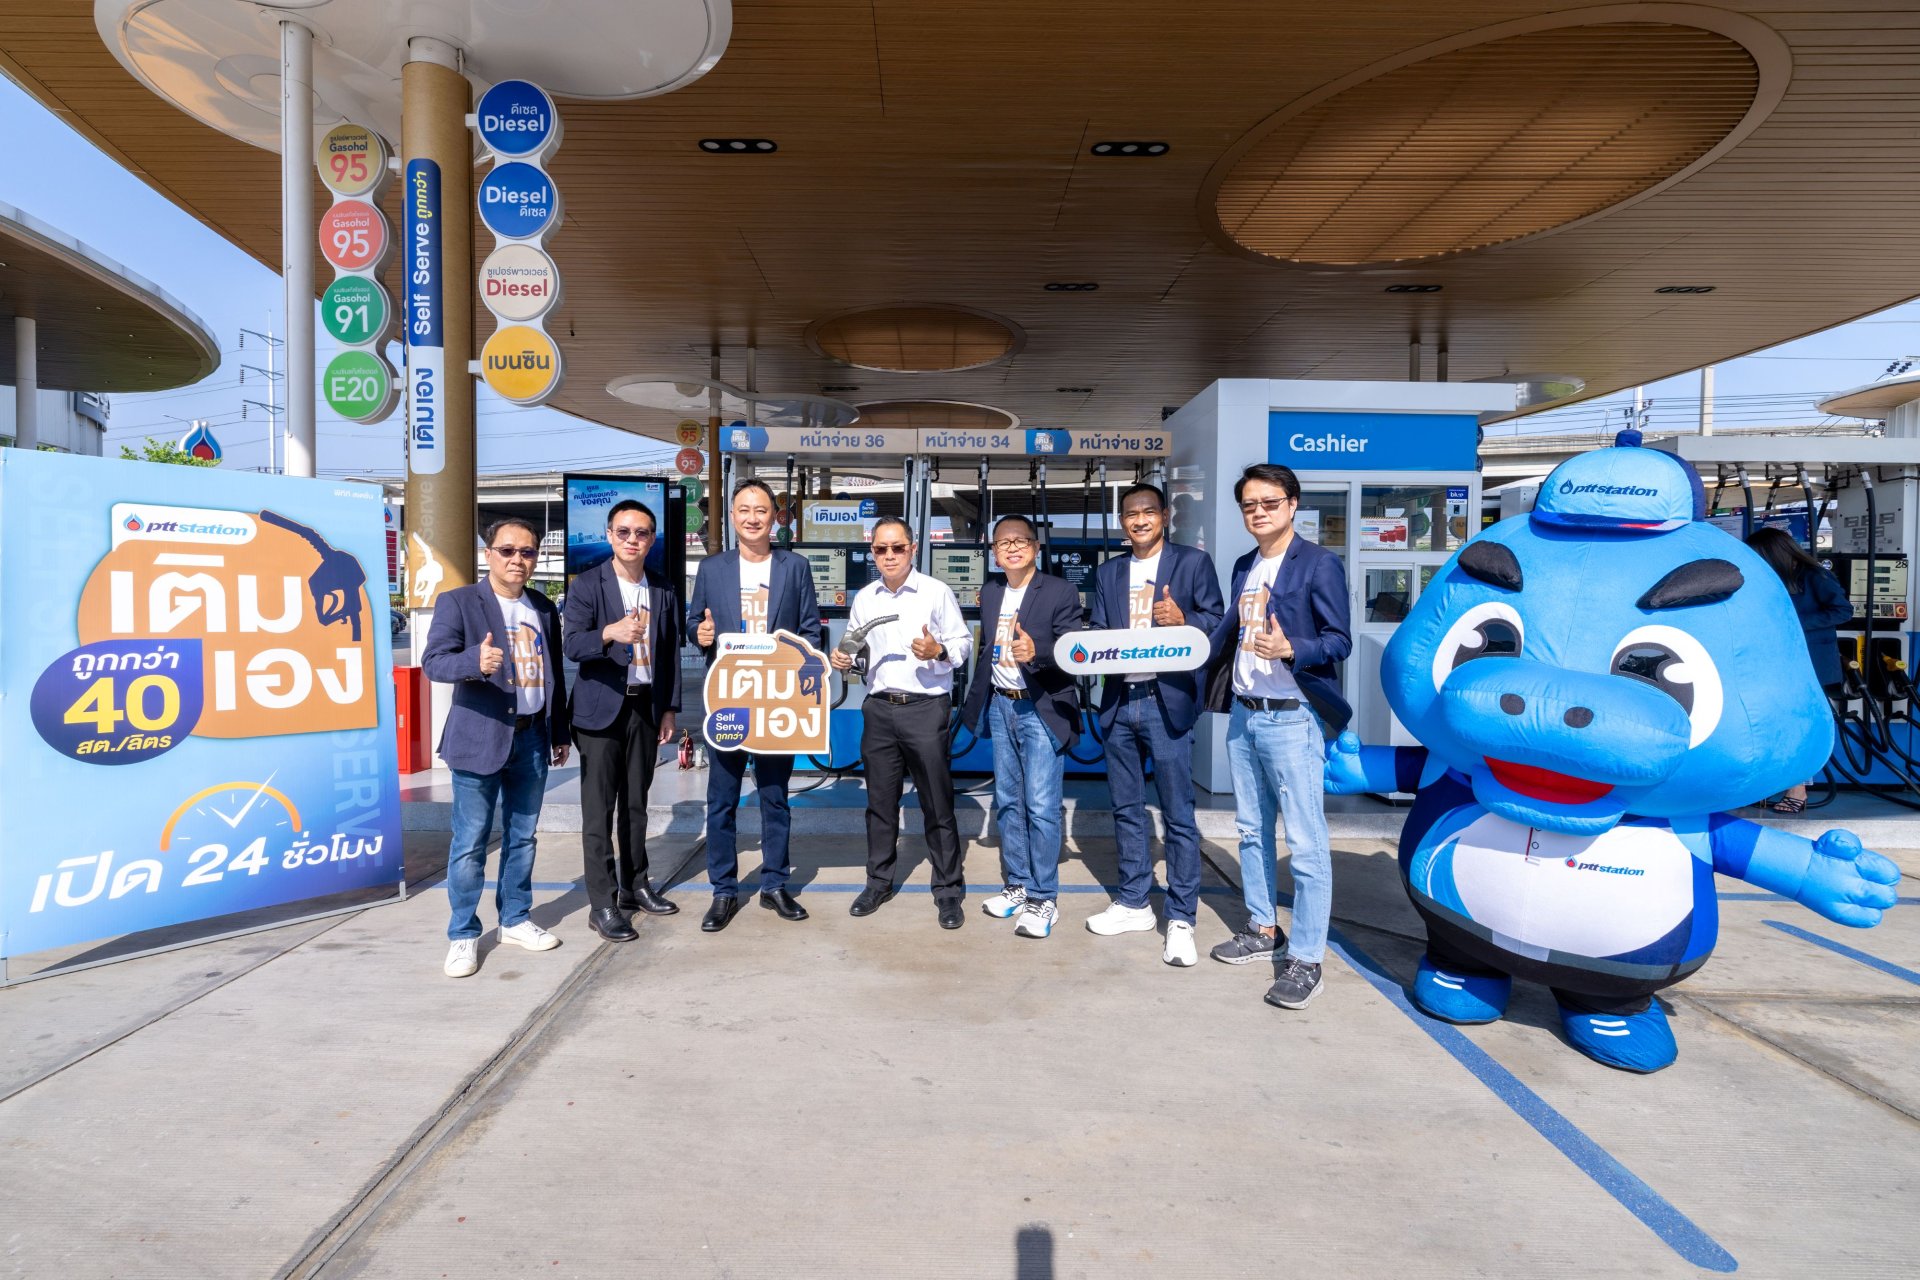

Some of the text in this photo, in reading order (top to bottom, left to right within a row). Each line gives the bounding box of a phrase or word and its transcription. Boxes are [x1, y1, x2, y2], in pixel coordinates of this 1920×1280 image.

[511, 103, 538, 115] ดีเซล
[484, 113, 545, 132] Diesel
[329, 142, 368, 153] Gasohol
[330, 153, 368, 182] 95
[486, 185, 547, 204] Diesel
[520, 205, 546, 217] ดีเซล
[333, 218, 370, 228] Gasohol
[333, 229, 370, 258] 95
[413, 171, 432, 336] Self Serve ถูกกว่า
[487, 266, 548, 279] ซูเปอร์พาวเวอร์
[486, 279, 548, 297] Diesel
[333, 293, 370, 303] Gasohol
[335, 304, 369, 333] 91
[488, 350, 550, 370] เบนซิน
[331, 376, 379, 402] E20
[412, 367, 434, 450] เติมเอง
[681, 431, 697, 442] 95
[800, 432, 885, 448] หน้าจ่าย 36
[925, 432, 1010, 449] หน้าจ่าย 34
[1080, 433, 1163, 451] หน้าจ่าย 32
[1289, 433, 1368, 452] Cashier
[681, 460, 697, 472] 95
[581, 498, 611, 507] ของคุณ
[815, 509, 857, 522] เติมเอง
[110, 554, 302, 634] เติม
[72, 645, 179, 680] ถูกกว่า
[215, 647, 364, 712] เอง
[718, 659, 795, 700] เติม
[63, 674, 181, 734] 40
[715, 713, 735, 722] Self
[715, 722, 744, 732] Serve
[755, 707, 821, 738] เอง
[76, 734, 172, 756] สต./ลิตร
[715, 732, 743, 743] ถูกกว่า
[29, 832, 384, 914] เปิด 24 ชั่วโมง
